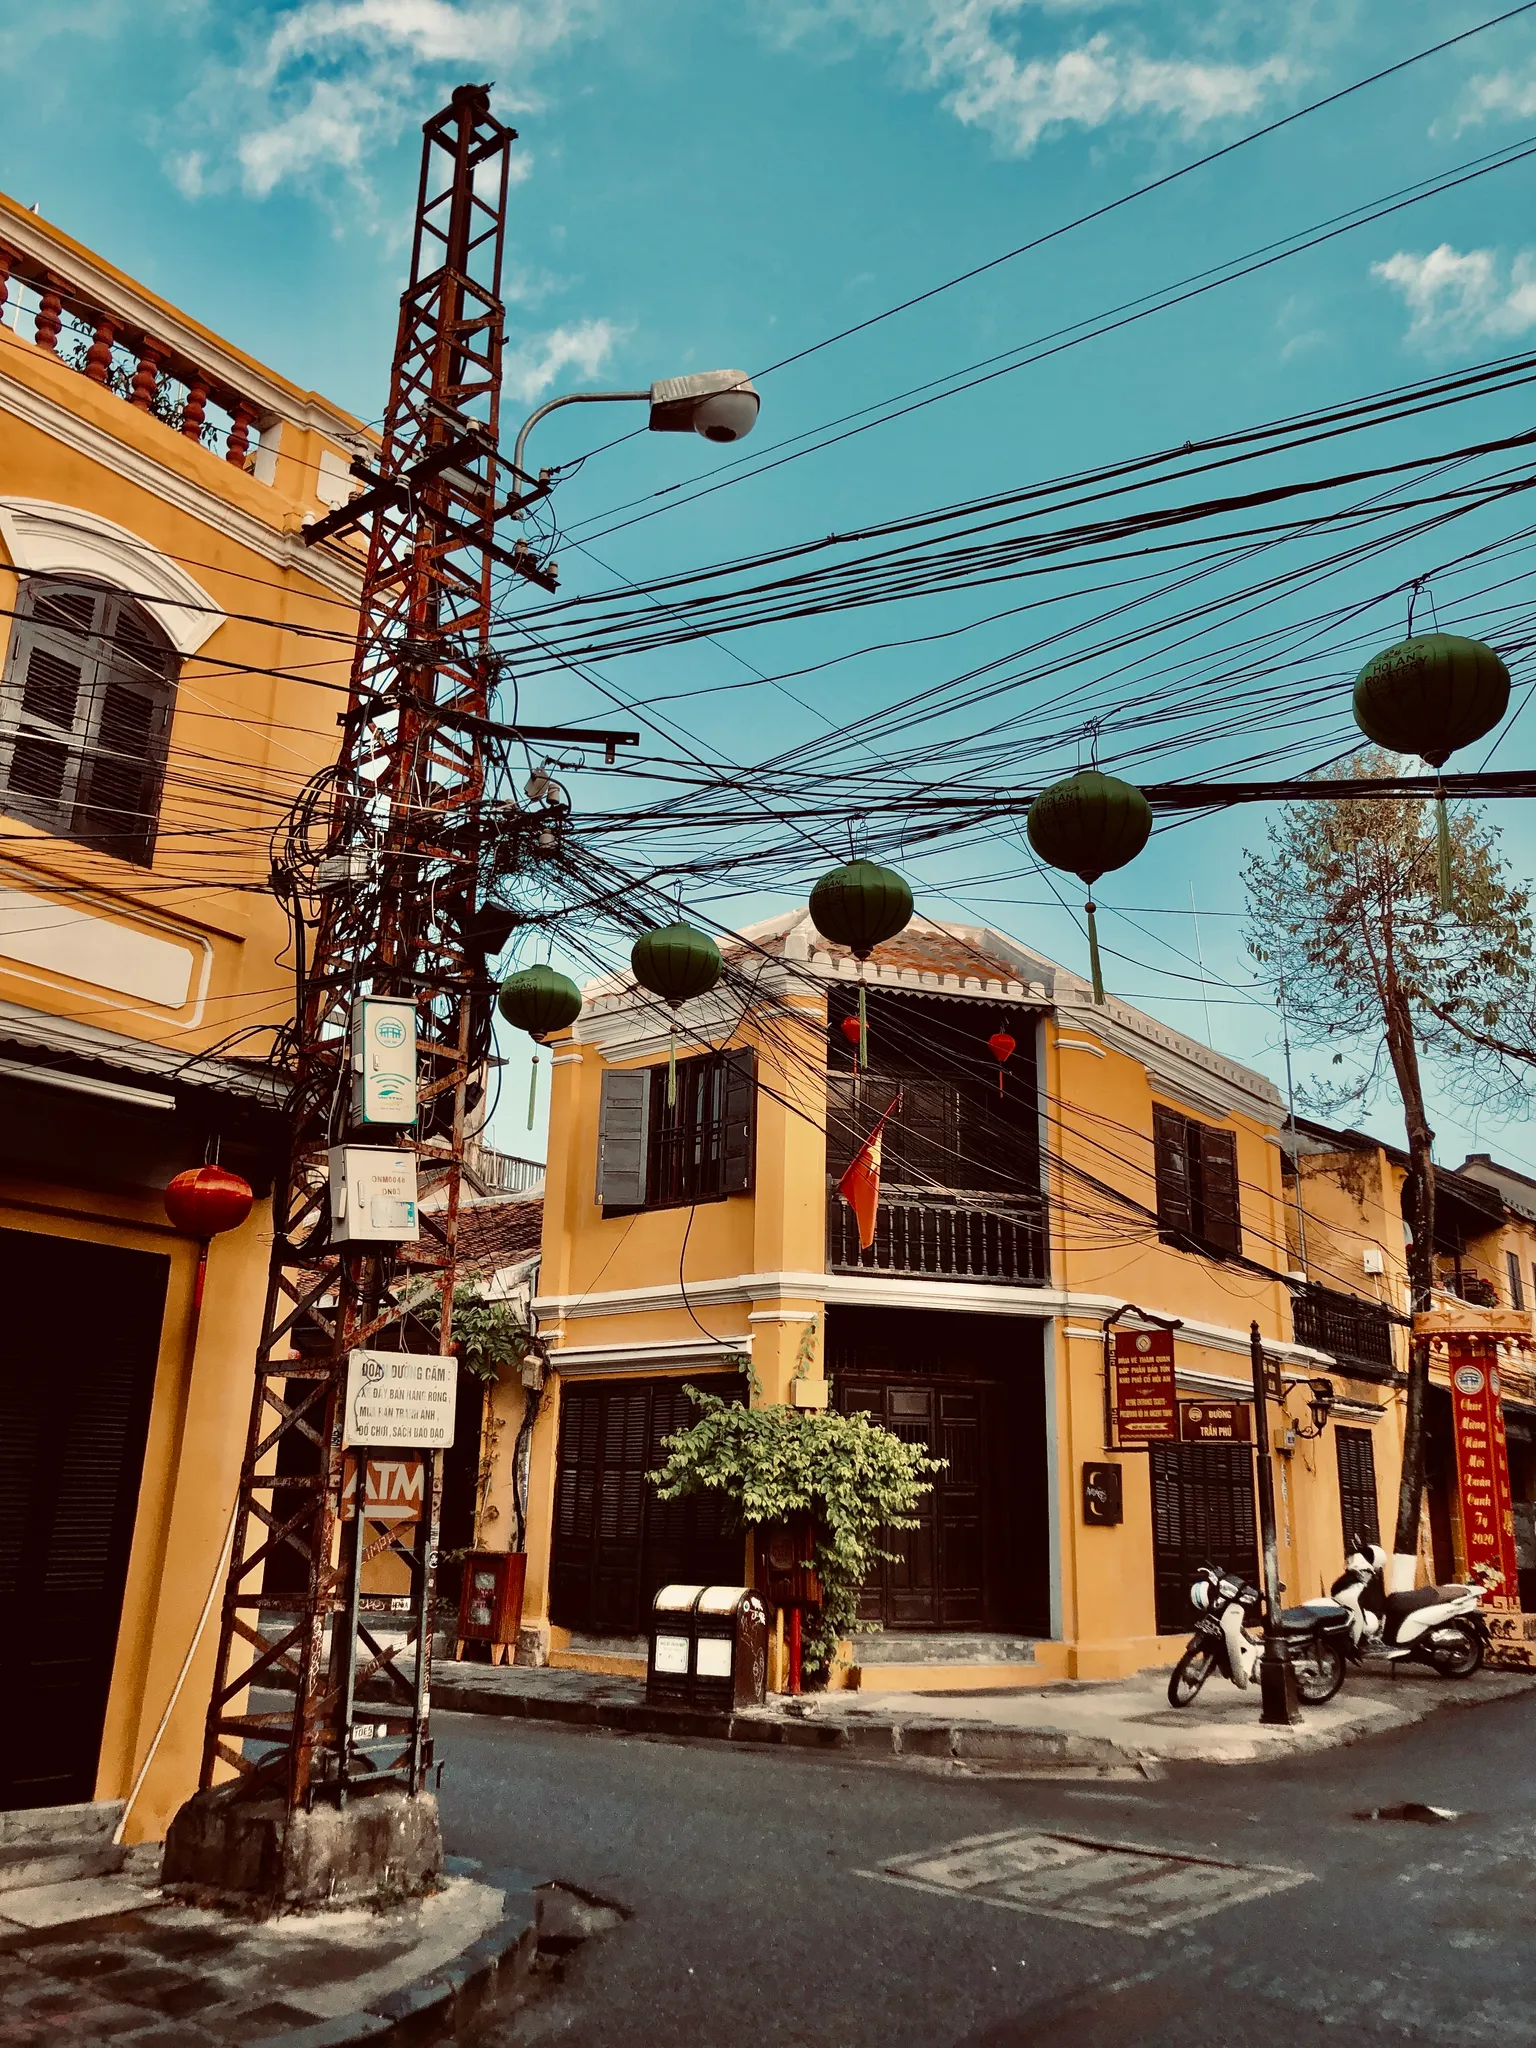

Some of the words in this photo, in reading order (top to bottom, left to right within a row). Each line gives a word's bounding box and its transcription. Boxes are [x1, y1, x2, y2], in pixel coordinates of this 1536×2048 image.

[1396, 652, 1416, 669] AN
[1199, 1423, 1217, 1437] TRẦN
[342, 1462, 425, 1500] ATM
[1471, 1533, 1494, 1546] 2020
